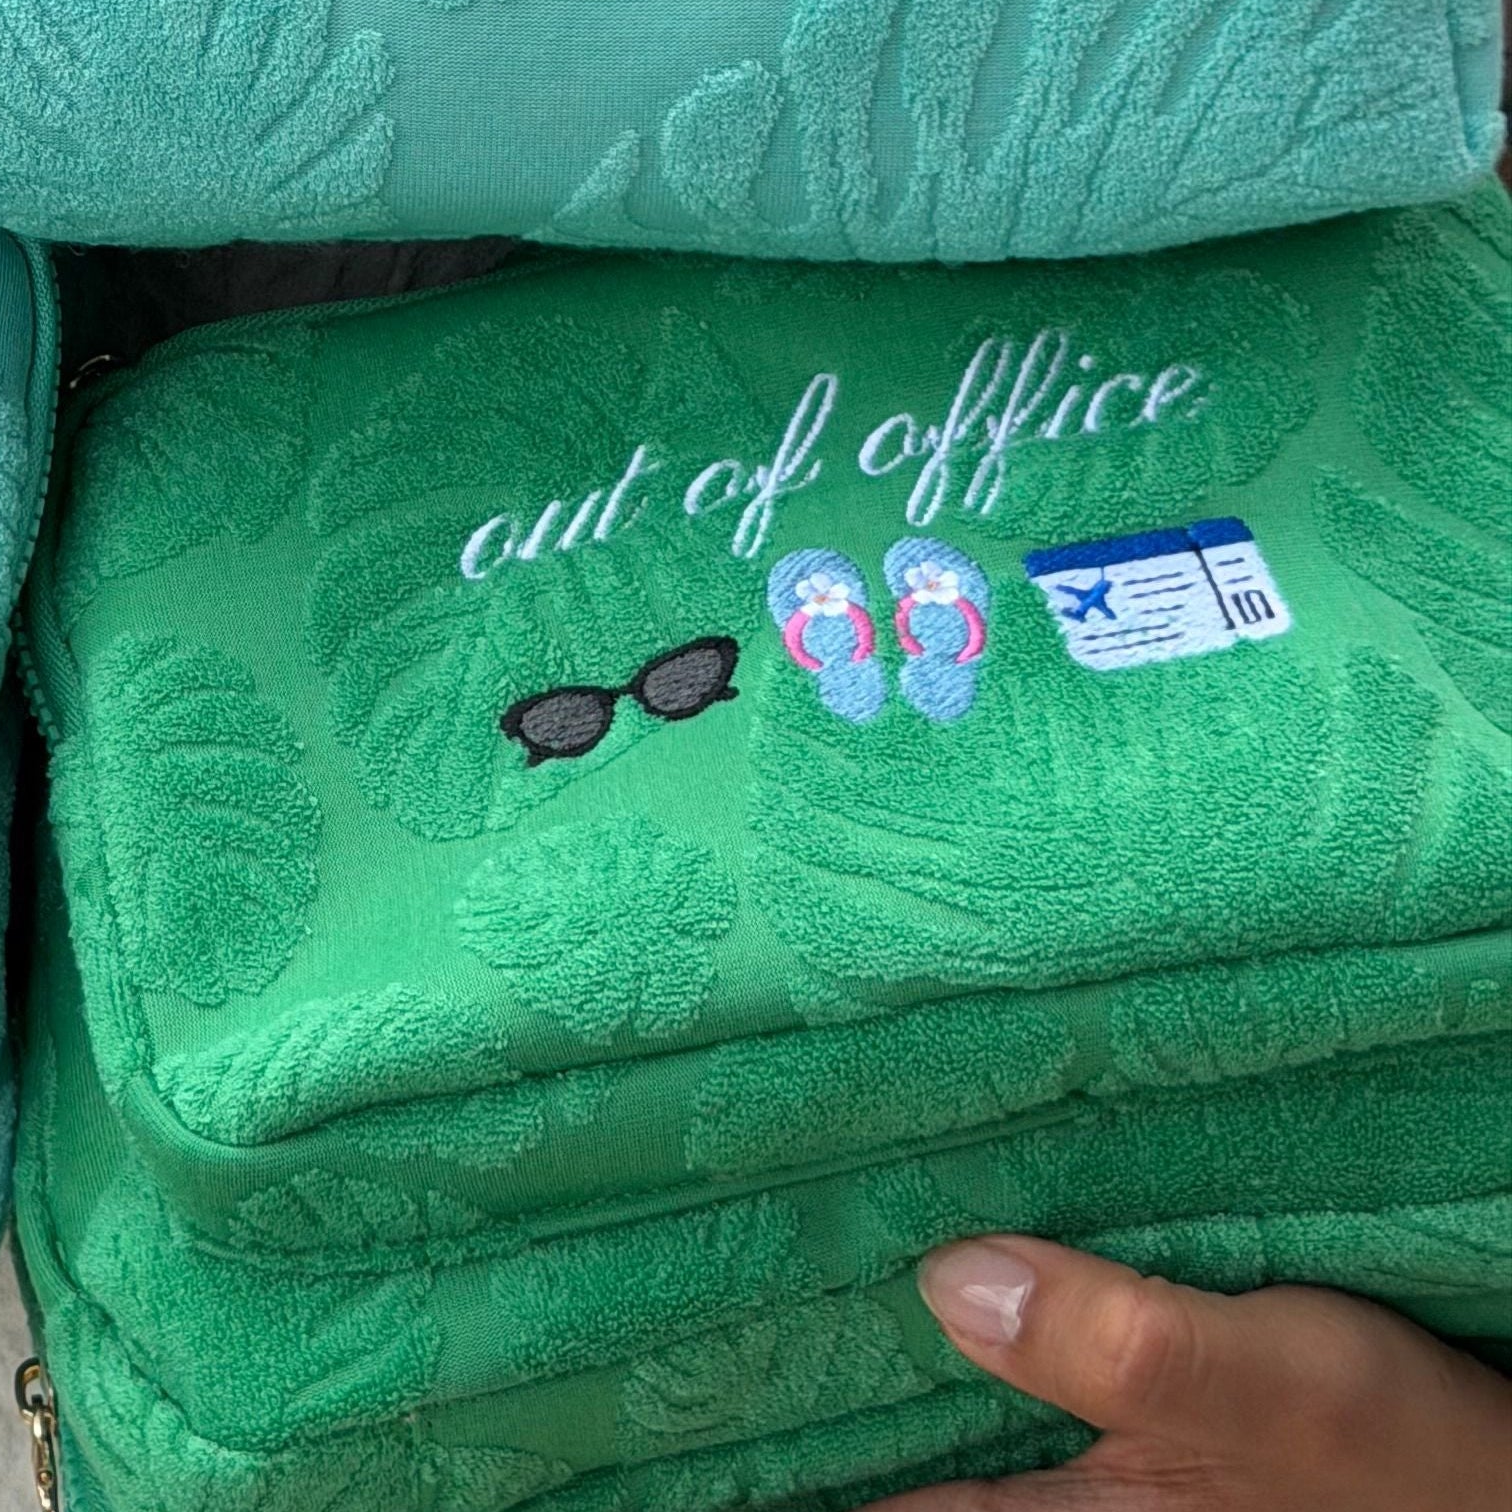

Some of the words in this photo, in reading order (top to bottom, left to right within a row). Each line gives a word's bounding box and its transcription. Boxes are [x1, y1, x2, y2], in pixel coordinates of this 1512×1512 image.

[459, 443, 658, 580] out
[684, 372, 839, 558] of
[858, 327, 1208, 526] office
